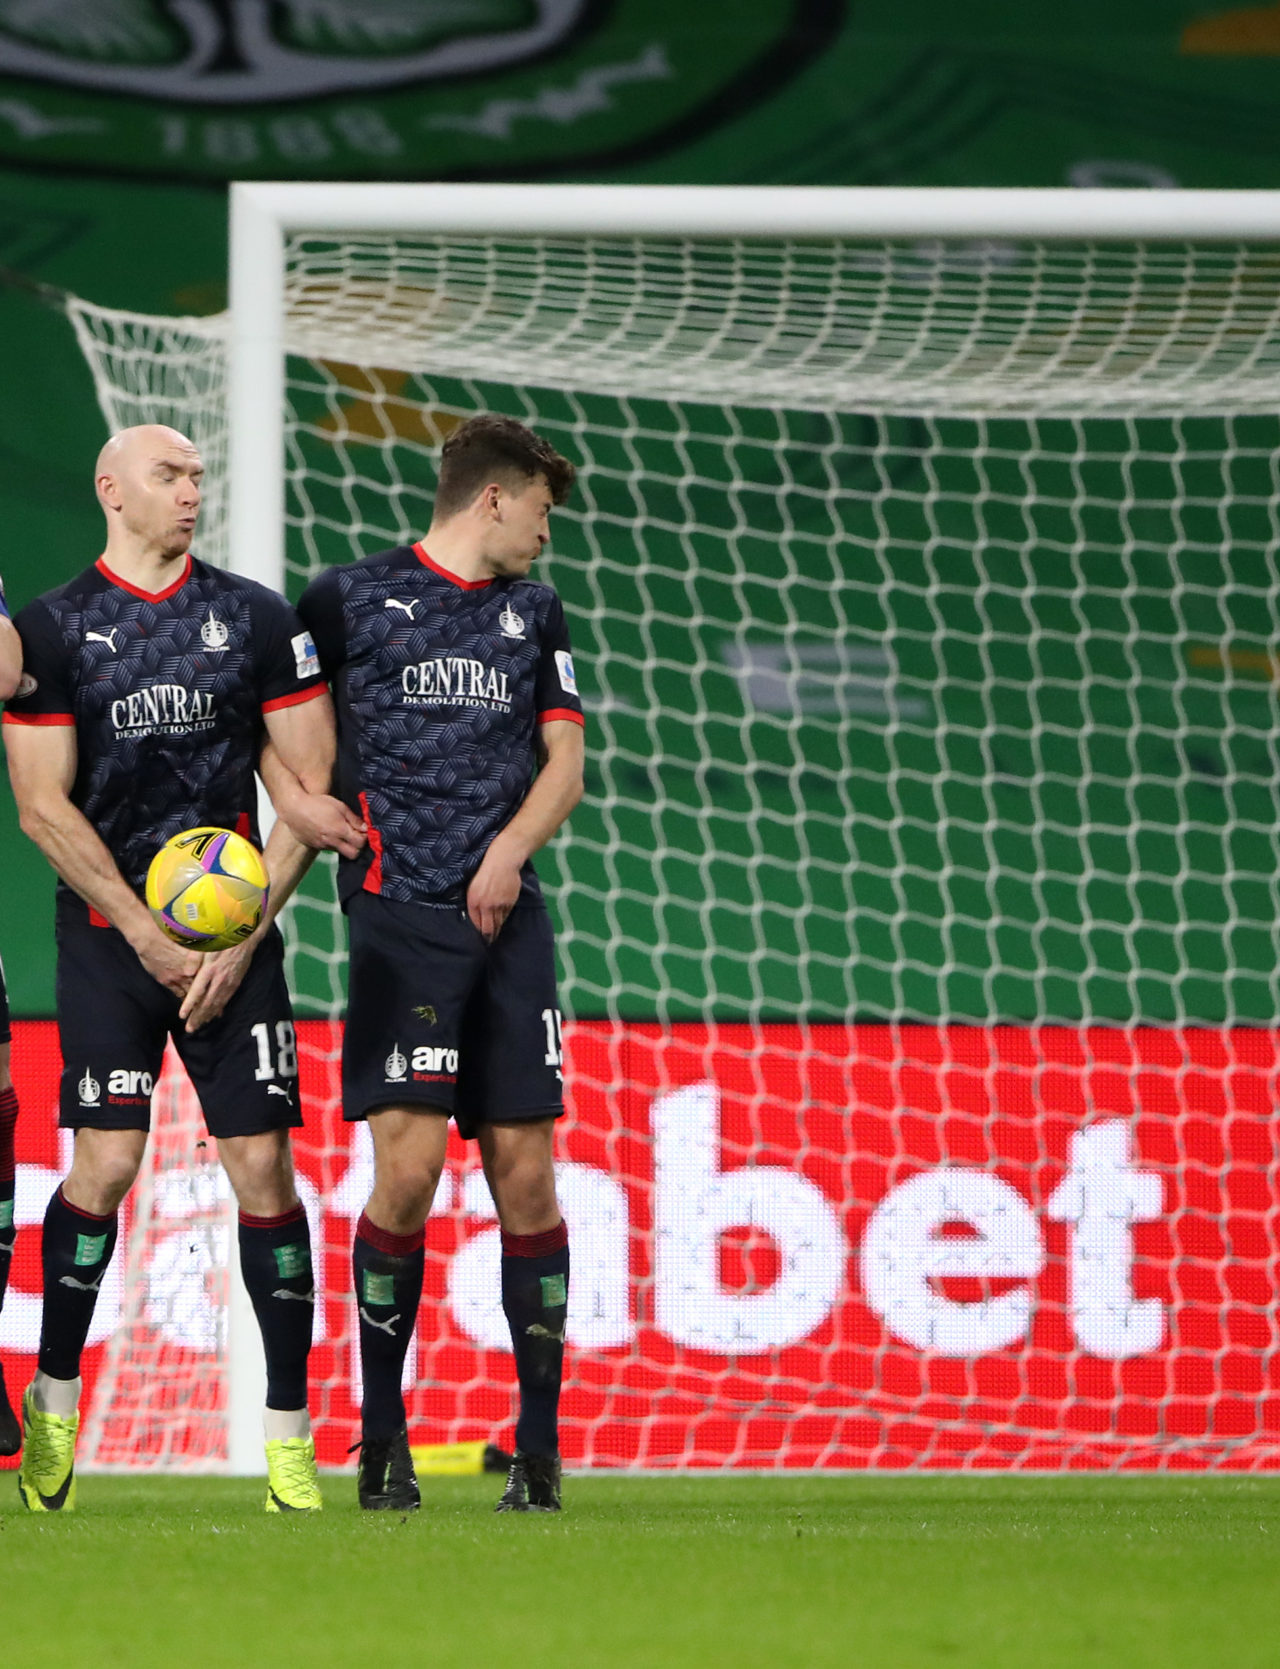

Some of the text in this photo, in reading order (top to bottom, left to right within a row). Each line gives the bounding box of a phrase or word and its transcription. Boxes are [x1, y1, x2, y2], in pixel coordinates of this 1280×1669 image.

[402, 657, 513, 704] CENTRAL
[111, 684, 218, 730] CENTRAL
[403, 696, 511, 714] DEMOLITION LTD
[115, 720, 216, 740] DEMOLITION LTD
[250, 1020, 298, 1081] 18
